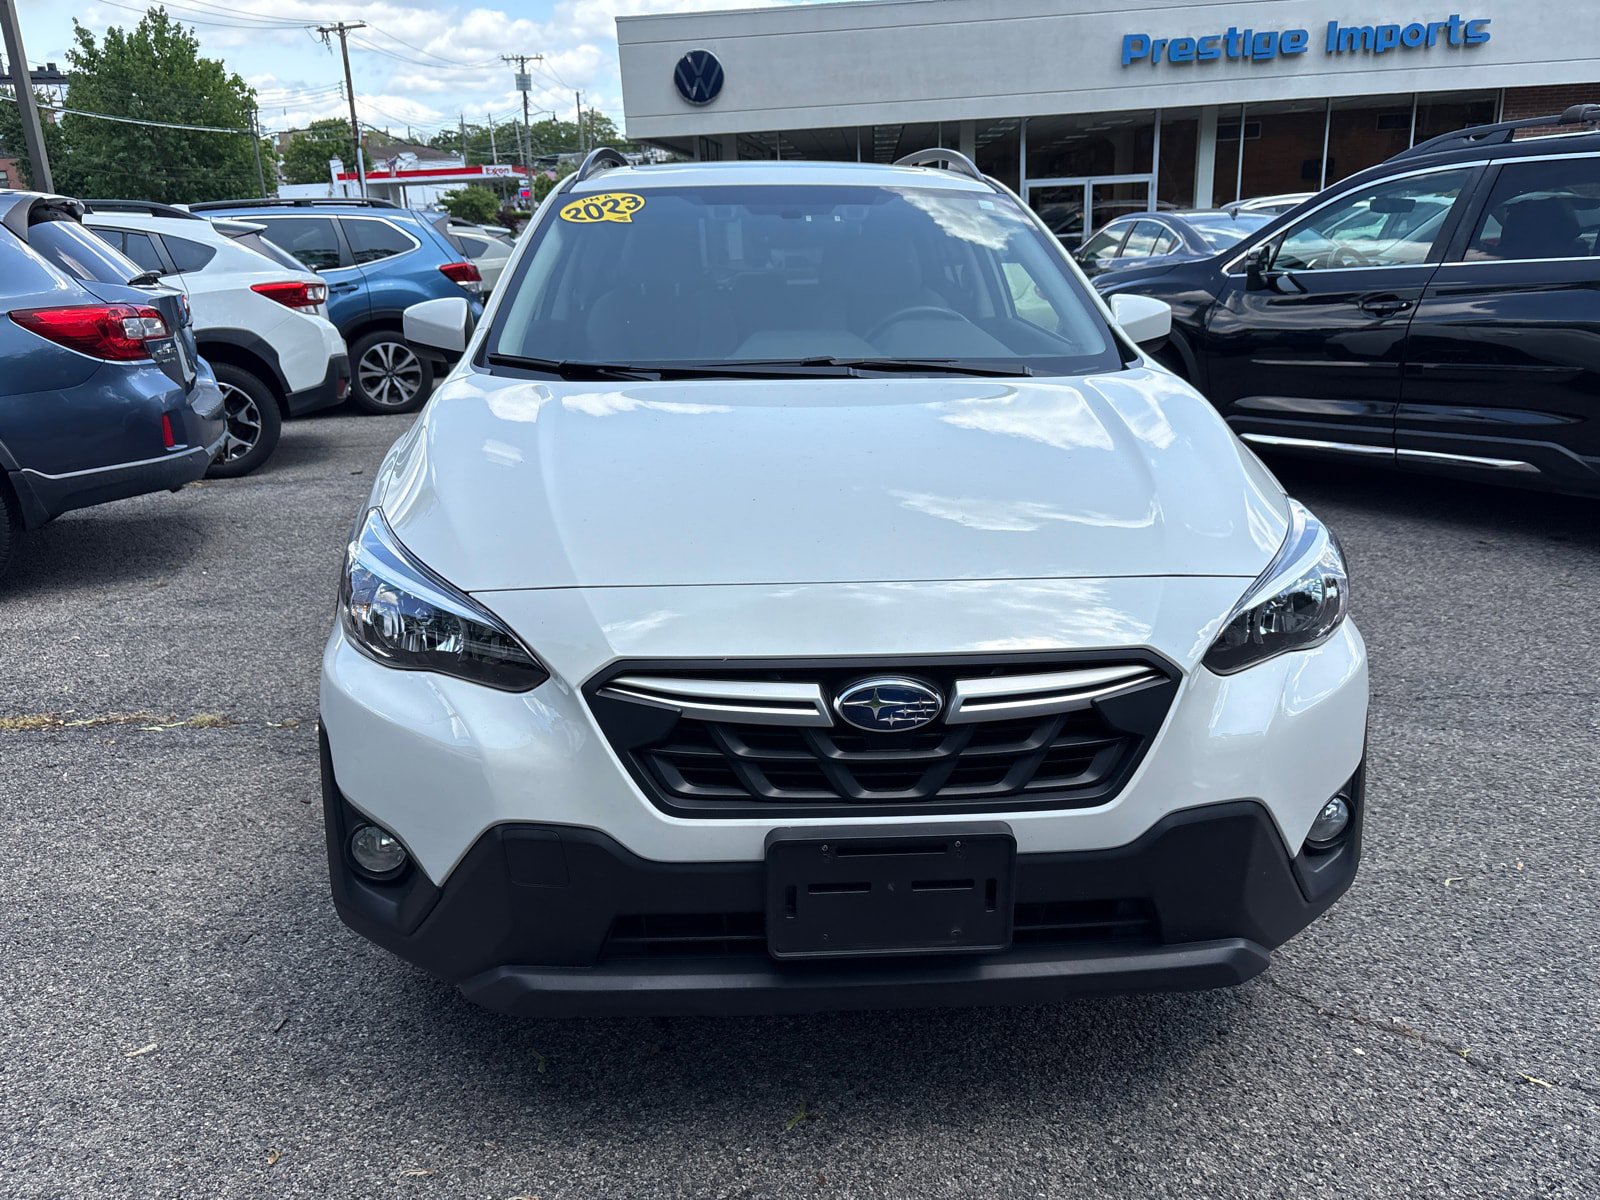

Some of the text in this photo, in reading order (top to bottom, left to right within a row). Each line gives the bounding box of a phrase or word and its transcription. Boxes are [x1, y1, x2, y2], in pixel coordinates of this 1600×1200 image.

[1121, 13, 1491, 66] Prestige Imports
[485, 167, 510, 177] Exxon
[565, 196, 642, 221] 2023
